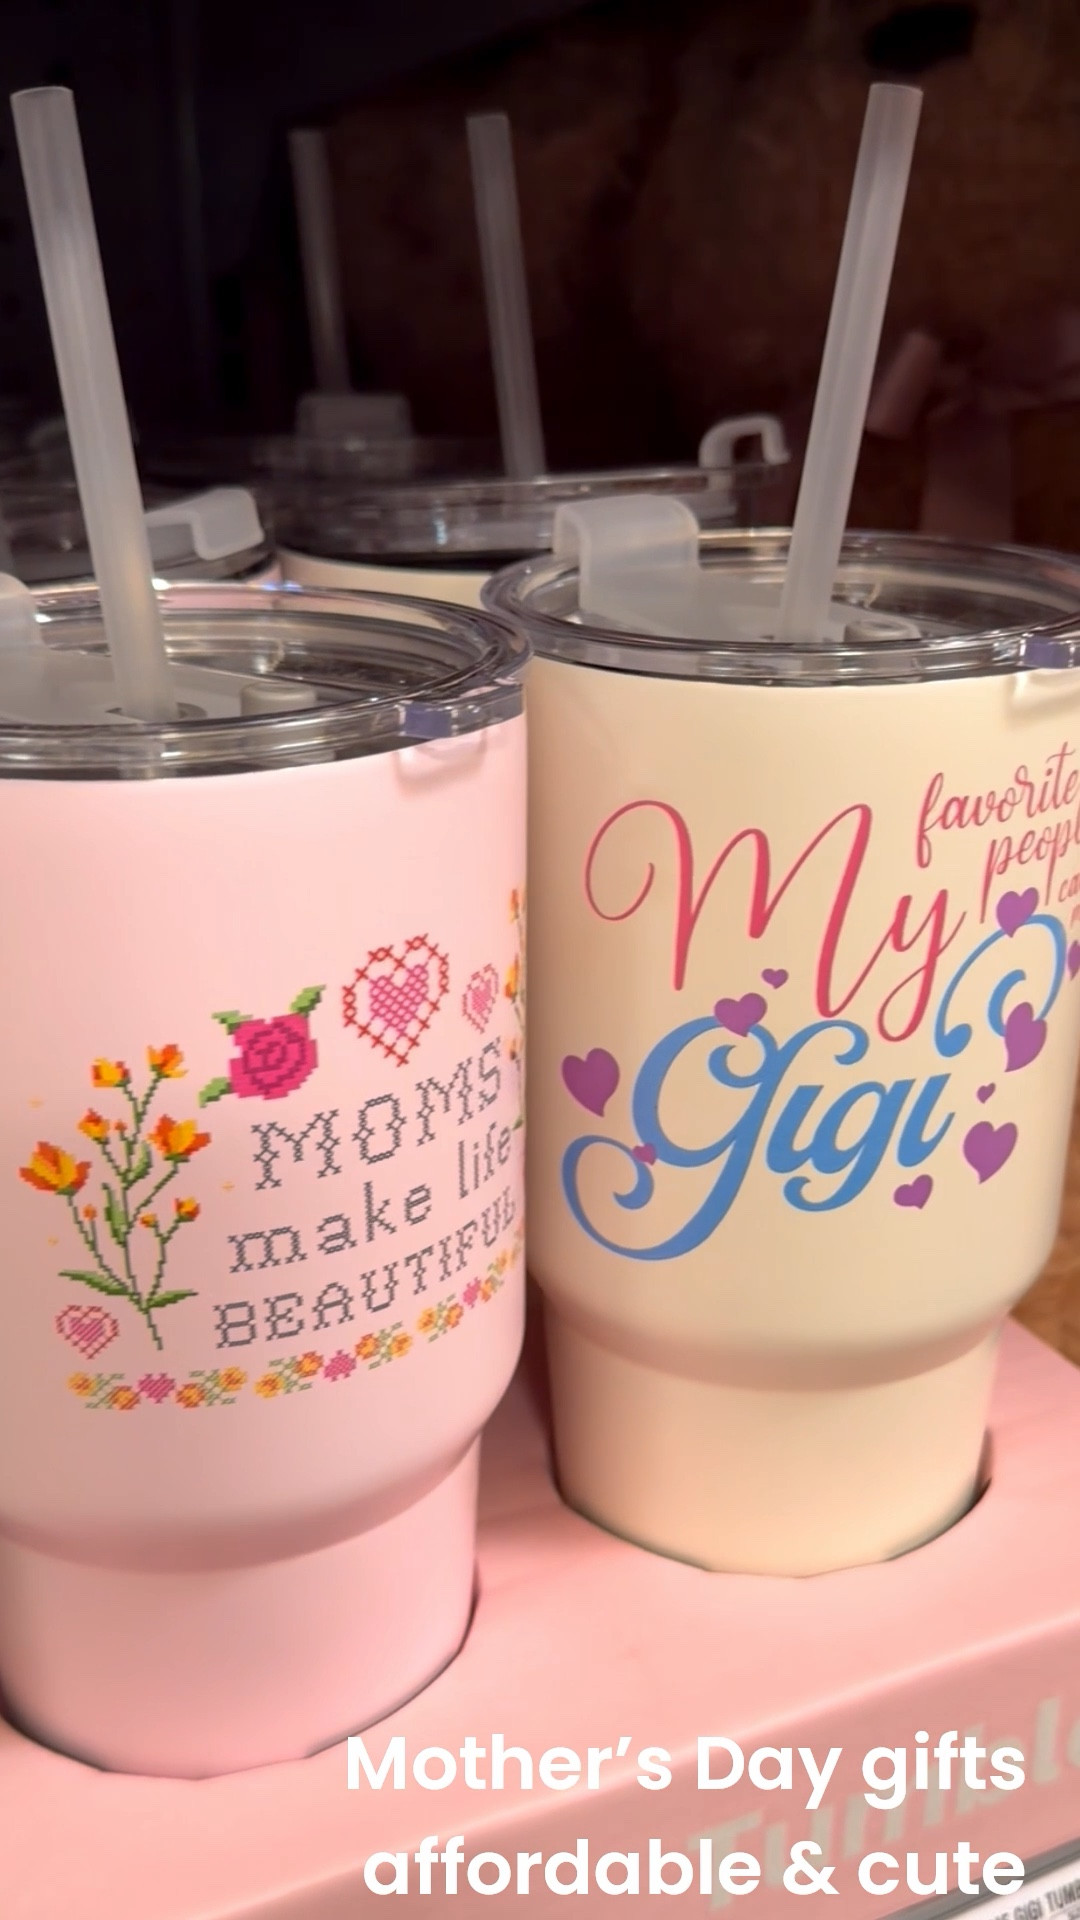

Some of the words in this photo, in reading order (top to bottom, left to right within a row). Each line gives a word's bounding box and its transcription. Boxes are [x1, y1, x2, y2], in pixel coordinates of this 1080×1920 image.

[917, 741, 1080, 869] favorite
[979, 798, 1080, 925] peopl
[585, 800, 968, 1042] My
[251, 1036, 500, 1190] MOMS
[561, 1015, 956, 1261] Gigi
[213, 1185, 516, 1348] BEAUTIFUL
[228, 1180, 432, 1273] make
[458, 1121, 511, 1200] life
